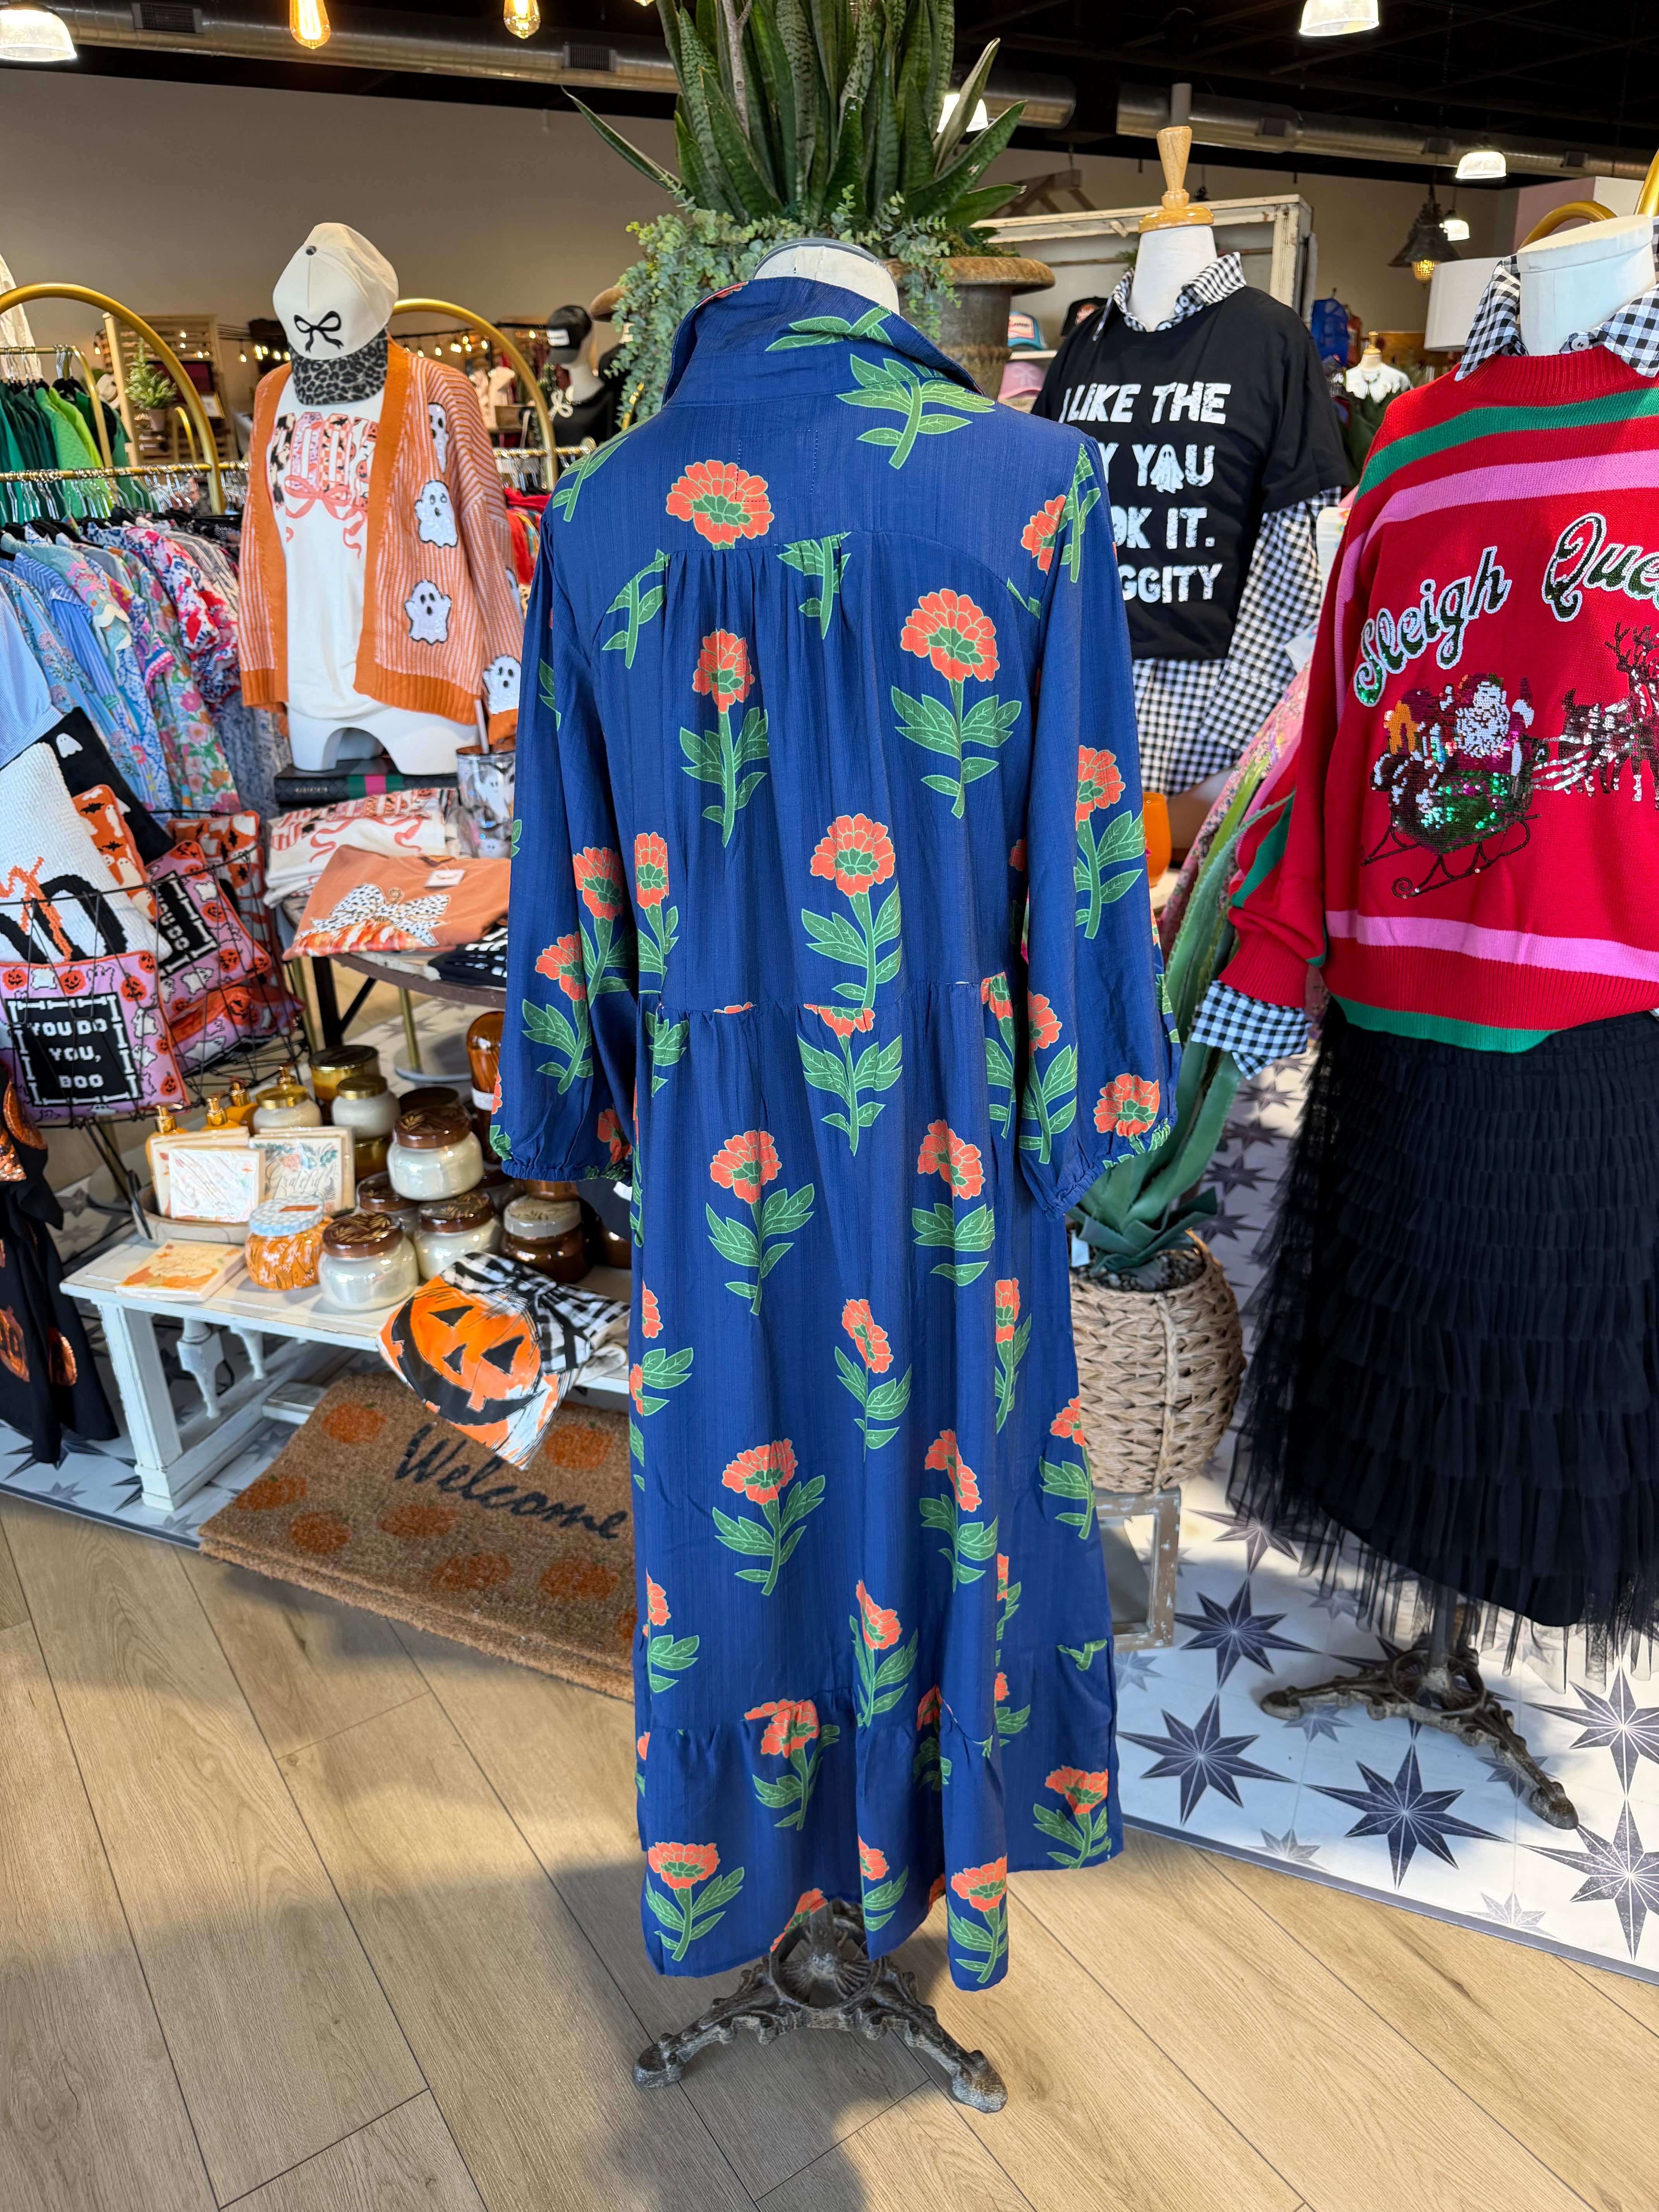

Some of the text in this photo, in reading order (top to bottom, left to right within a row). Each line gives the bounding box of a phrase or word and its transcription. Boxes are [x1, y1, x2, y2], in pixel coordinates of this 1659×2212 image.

[1066, 383, 1141, 422] LIKE
[1151, 381, 1231, 424] THE
[1166, 507, 1215, 550] IT.
[1118, 563, 1223, 604] GGITY
[1353, 512, 1659, 707] Sleigh Que
[28, 1018, 108, 1036] YOU DO
[48, 1046, 102, 1063] YOU,
[58, 1073, 104, 1089] BOO
[394, 1423, 628, 1539] Welcome
